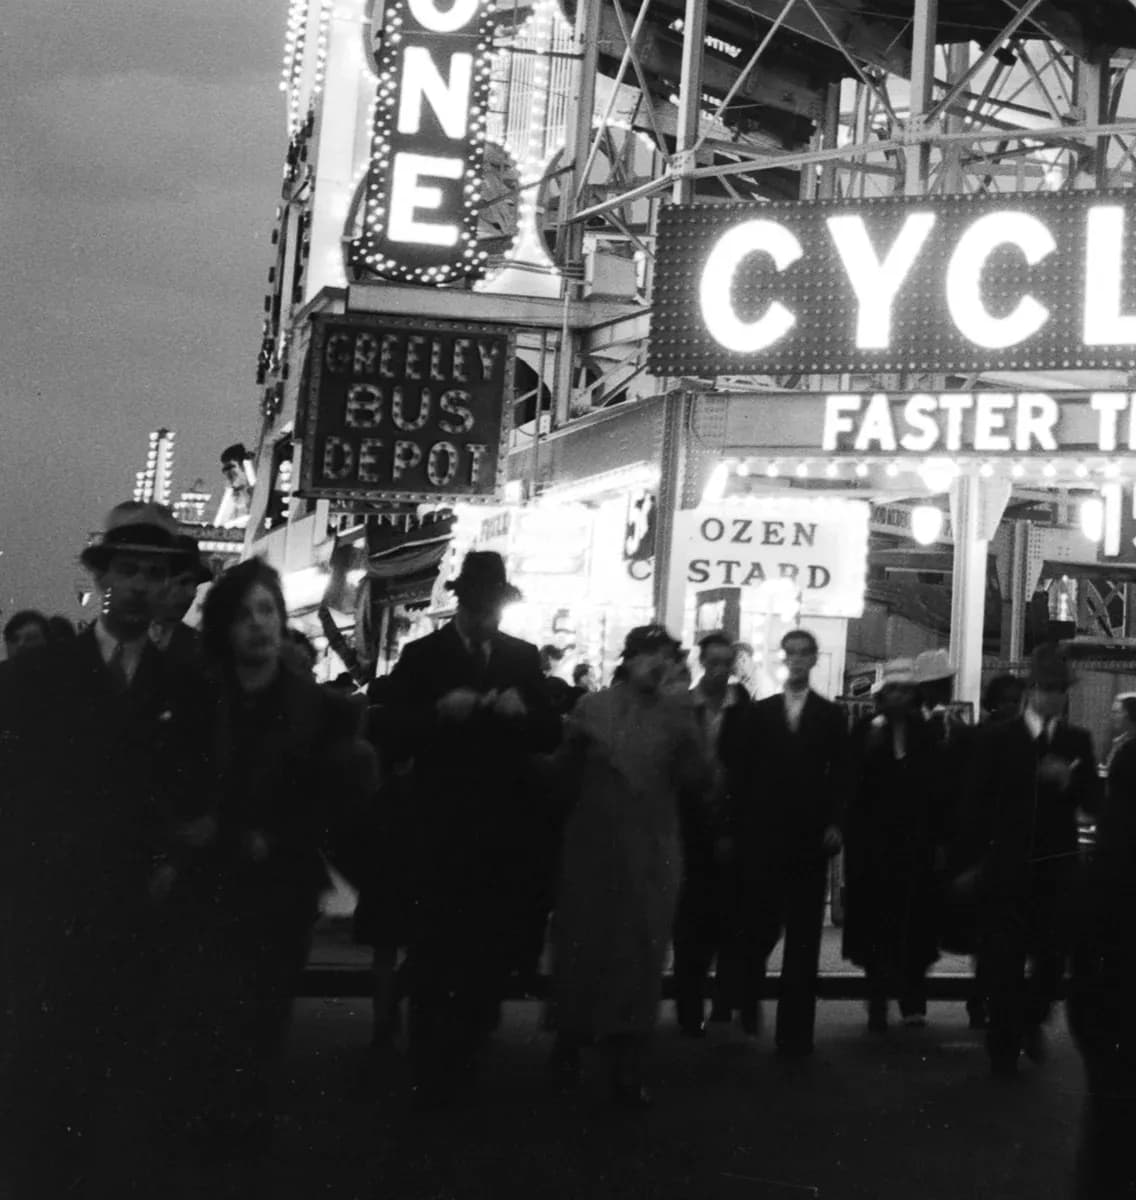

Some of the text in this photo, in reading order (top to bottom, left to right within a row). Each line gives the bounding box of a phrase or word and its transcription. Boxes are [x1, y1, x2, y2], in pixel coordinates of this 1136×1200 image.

[346, 383, 475, 434] BUS
[821, 393, 1060, 452] FASTER
[322, 435, 488, 487] DEPOT
[700, 517, 819, 547] OZEN
